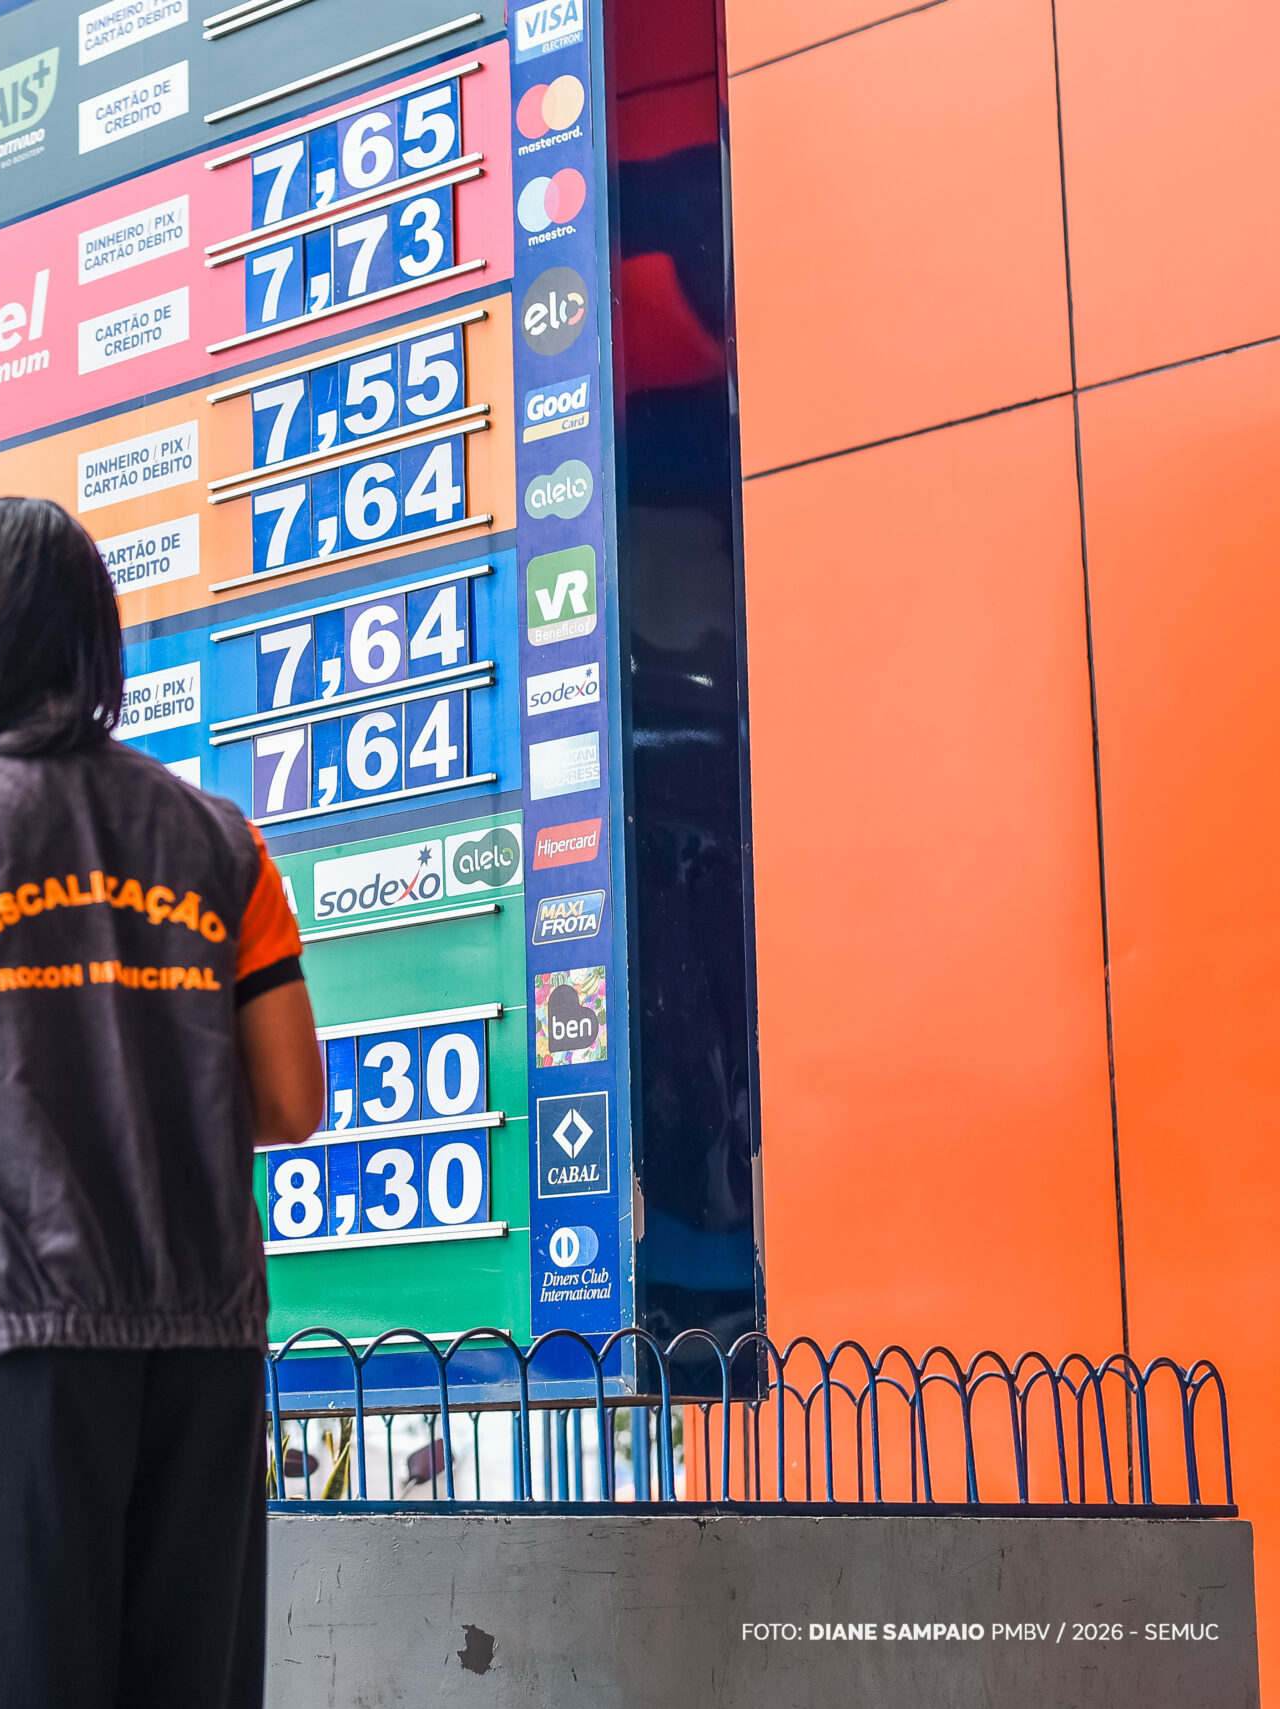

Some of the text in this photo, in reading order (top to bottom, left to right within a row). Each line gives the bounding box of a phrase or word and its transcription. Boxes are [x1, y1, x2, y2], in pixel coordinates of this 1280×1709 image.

[86, 2, 144, 34] DINHEIRO
[524, 0, 579, 38] VISA
[542, 31, 581, 53] ELECTRON
[154, 80, 171, 97] DE
[252, 86, 456, 226] 7,65
[86, 223, 144, 254] DINHEIRO
[154, 211, 175, 229] PIX
[84, 243, 134, 270] CARTÃO
[252, 197, 445, 323] 7,73
[95, 305, 171, 341] CARTÃO DE
[524, 291, 584, 336] elo
[104, 326, 162, 356] CRÉDITO
[253, 332, 459, 465] 7,55
[527, 381, 587, 421] Good
[561, 416, 585, 430] Card
[86, 448, 150, 479] DINHEIRO
[161, 437, 183, 457] PIX
[84, 454, 192, 498] CARTÃO DÉBITO
[254, 442, 461, 568] 7,64
[531, 477, 587, 508] alelo
[161, 533, 180, 552] DE
[534, 569, 588, 621] VR
[261, 586, 465, 708] 7,64
[163, 679, 186, 698] PIX
[529, 680, 598, 708] sodexo
[144, 697, 195, 722] DÉBITO
[256, 699, 458, 813] 7,64
[537, 830, 597, 858] Hipercard
[317, 866, 441, 917] sodexo
[459, 845, 514, 874] alelo
[540, 900, 585, 921] MAXI
[541, 914, 597, 937] FROTA
[89, 960, 221, 991] MNICIPAL
[552, 1016, 592, 1040] ben
[334, 1033, 480, 1131] ,30
[273, 1142, 483, 1238] 8,30
[548, 1164, 600, 1186] CABAL
[540, 1283, 612, 1303] International
[543, 1268, 609, 1287] Diners Club
